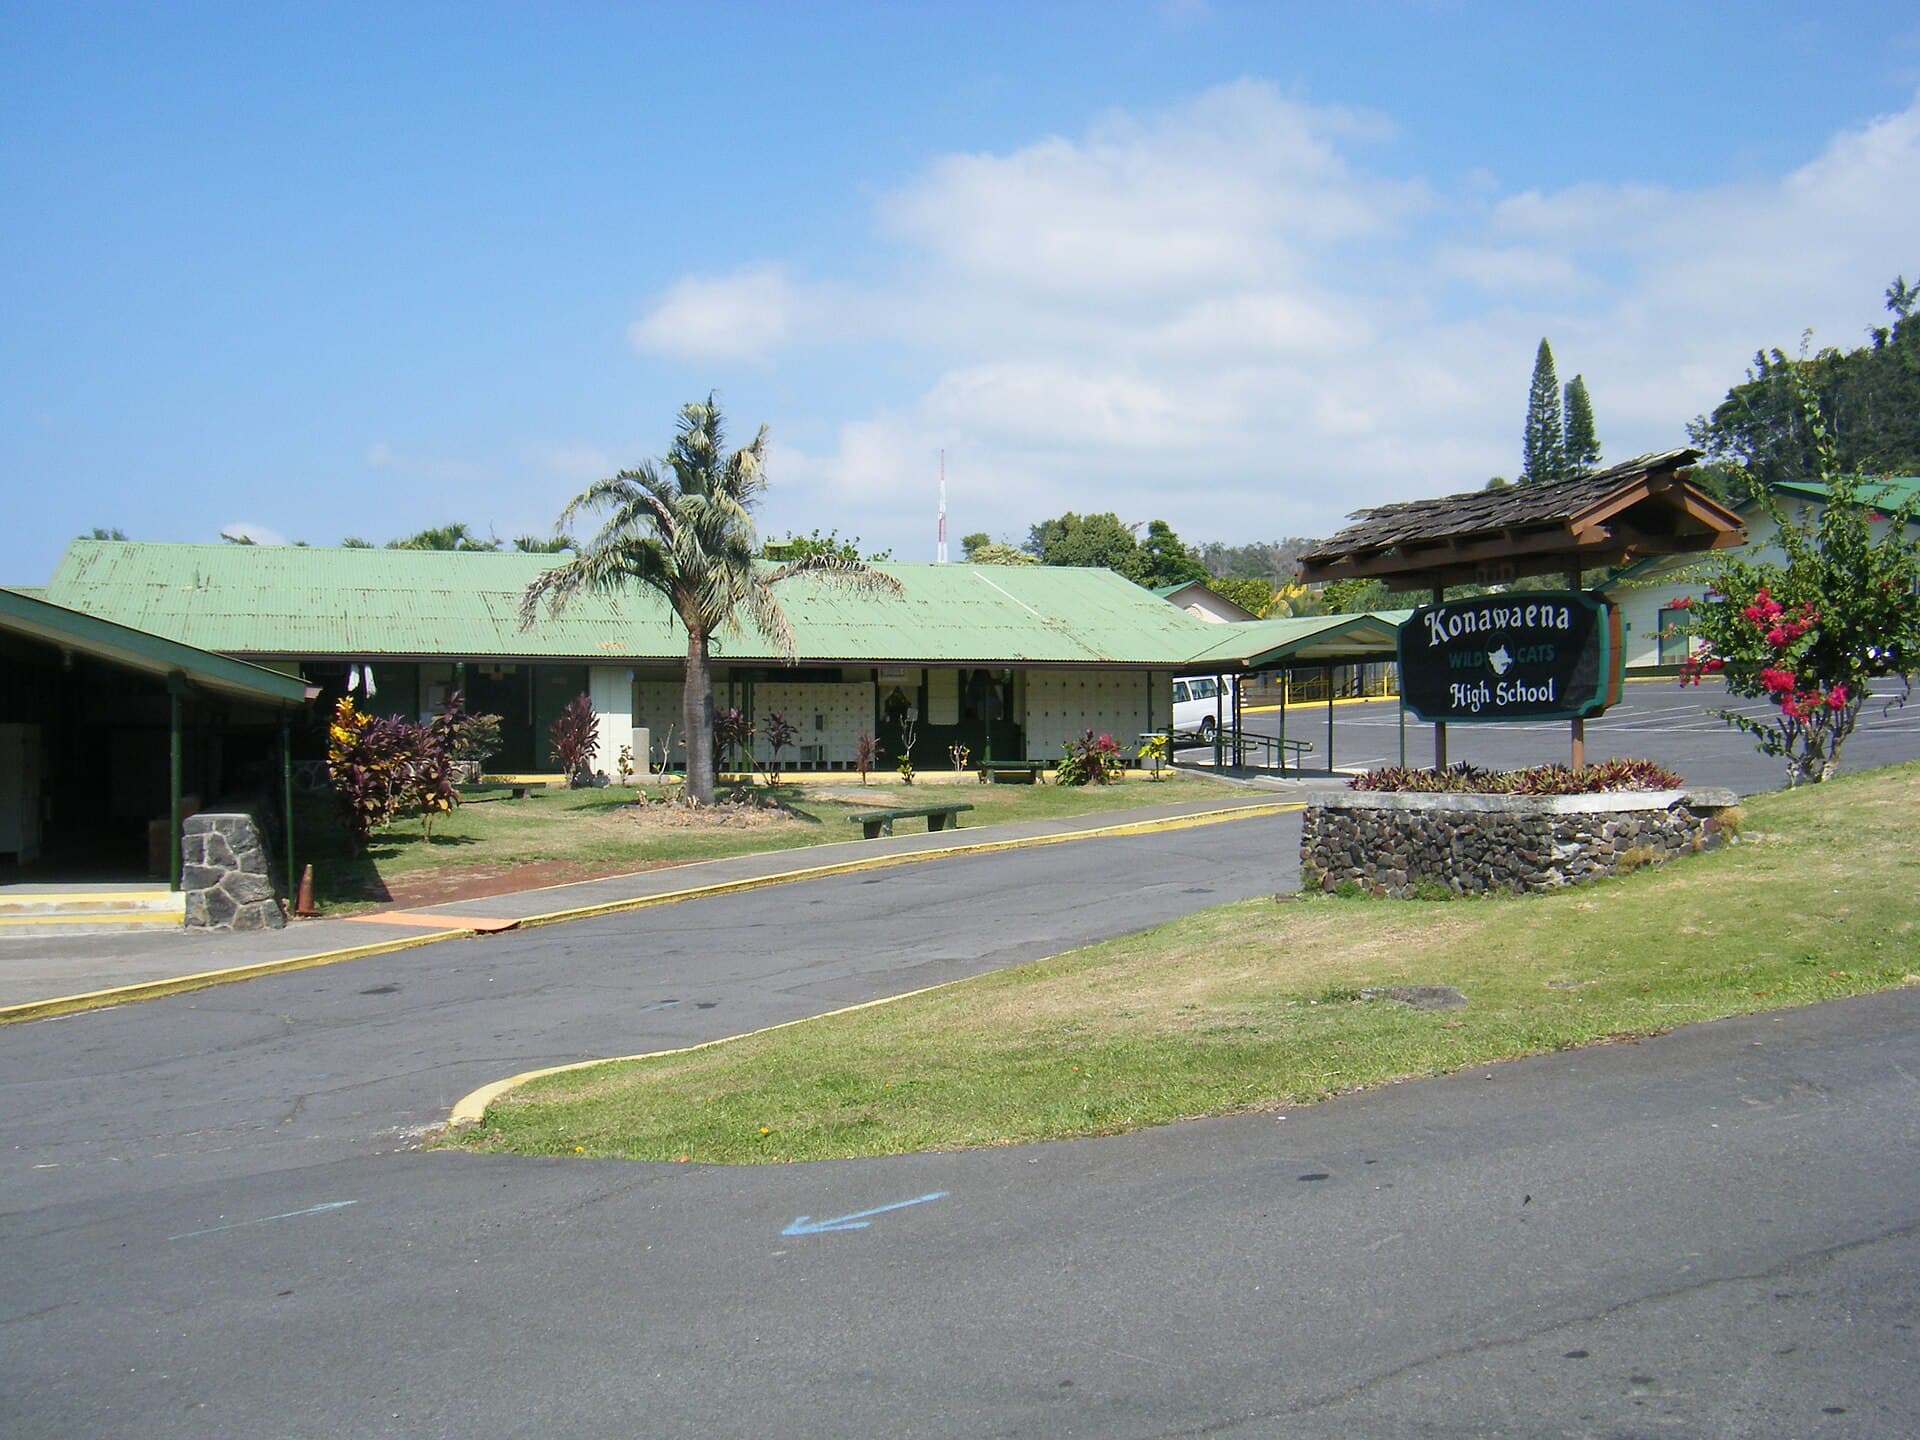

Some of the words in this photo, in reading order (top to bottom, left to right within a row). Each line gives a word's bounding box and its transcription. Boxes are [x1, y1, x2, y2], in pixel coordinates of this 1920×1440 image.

[1424, 605, 1570, 648] Konawaena
[1448, 650, 1482, 669] WILD
[1517, 644, 1555, 663] CATS
[1449, 680, 1490, 713] High
[1496, 677, 1555, 706] School
